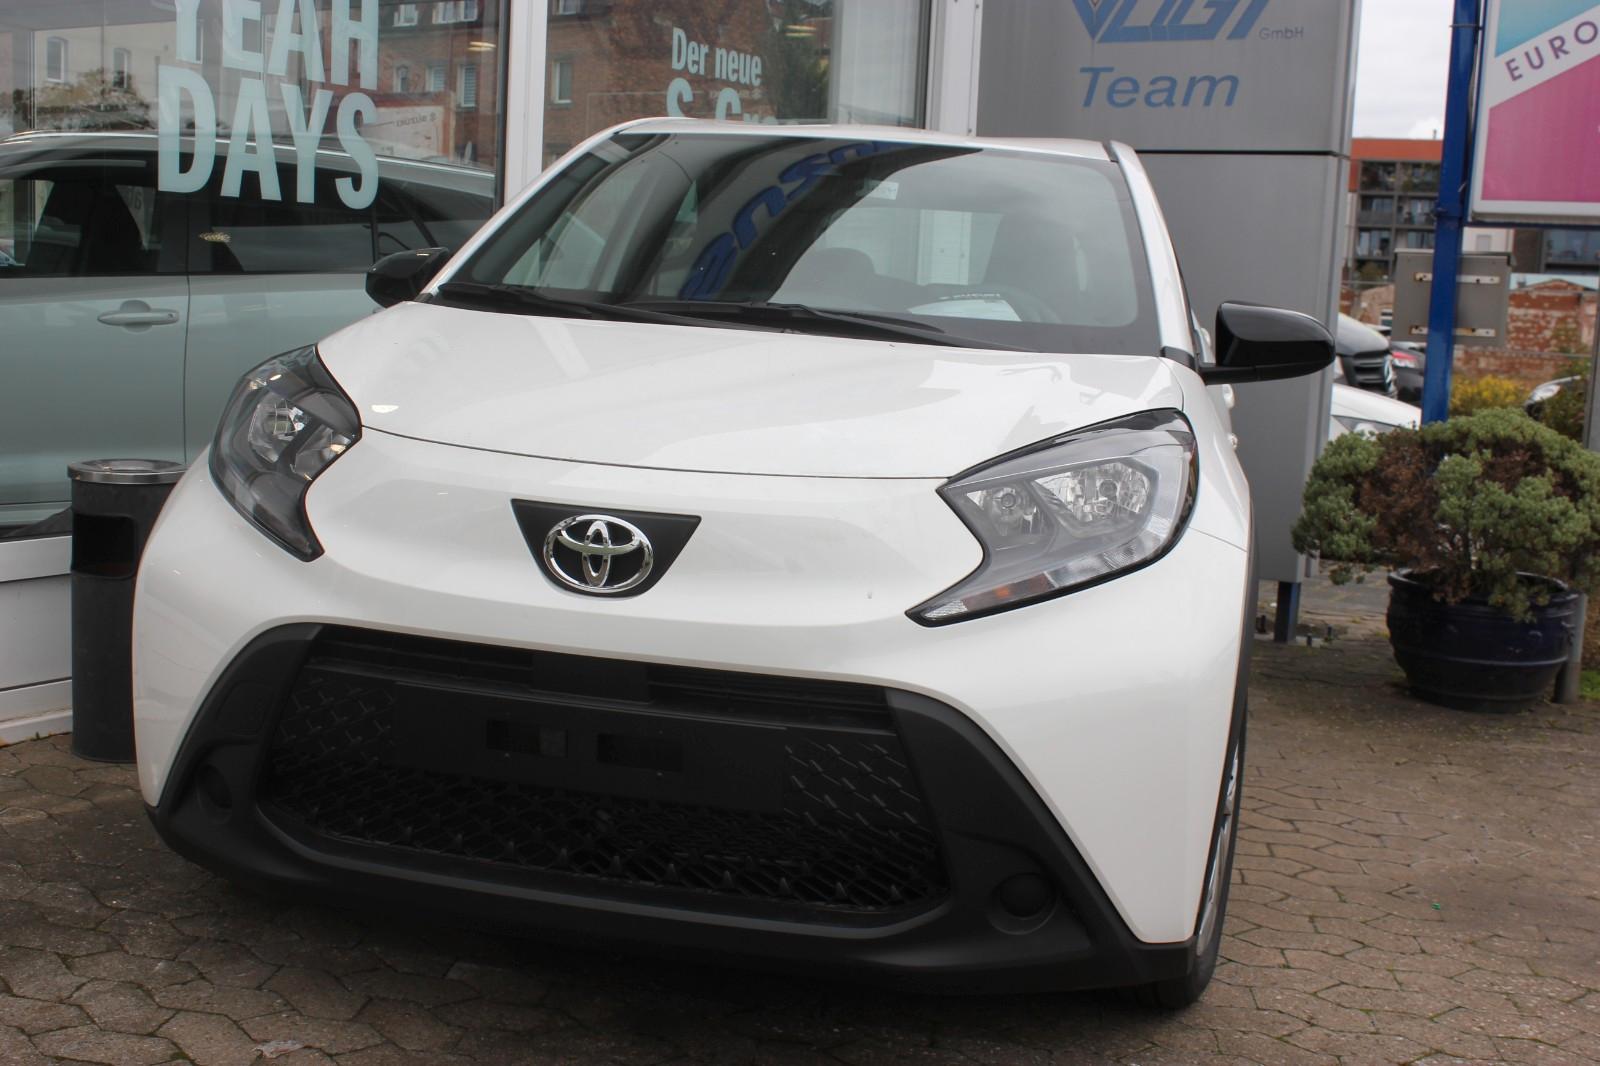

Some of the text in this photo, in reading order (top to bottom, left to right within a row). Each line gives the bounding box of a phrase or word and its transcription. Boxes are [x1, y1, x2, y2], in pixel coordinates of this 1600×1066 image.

[672, 27, 762, 87] Der neue
[1258, 26, 1304, 41] GmbH
[1080, 66, 1240, 108] Team
[158, 65, 379, 210] DAYS
